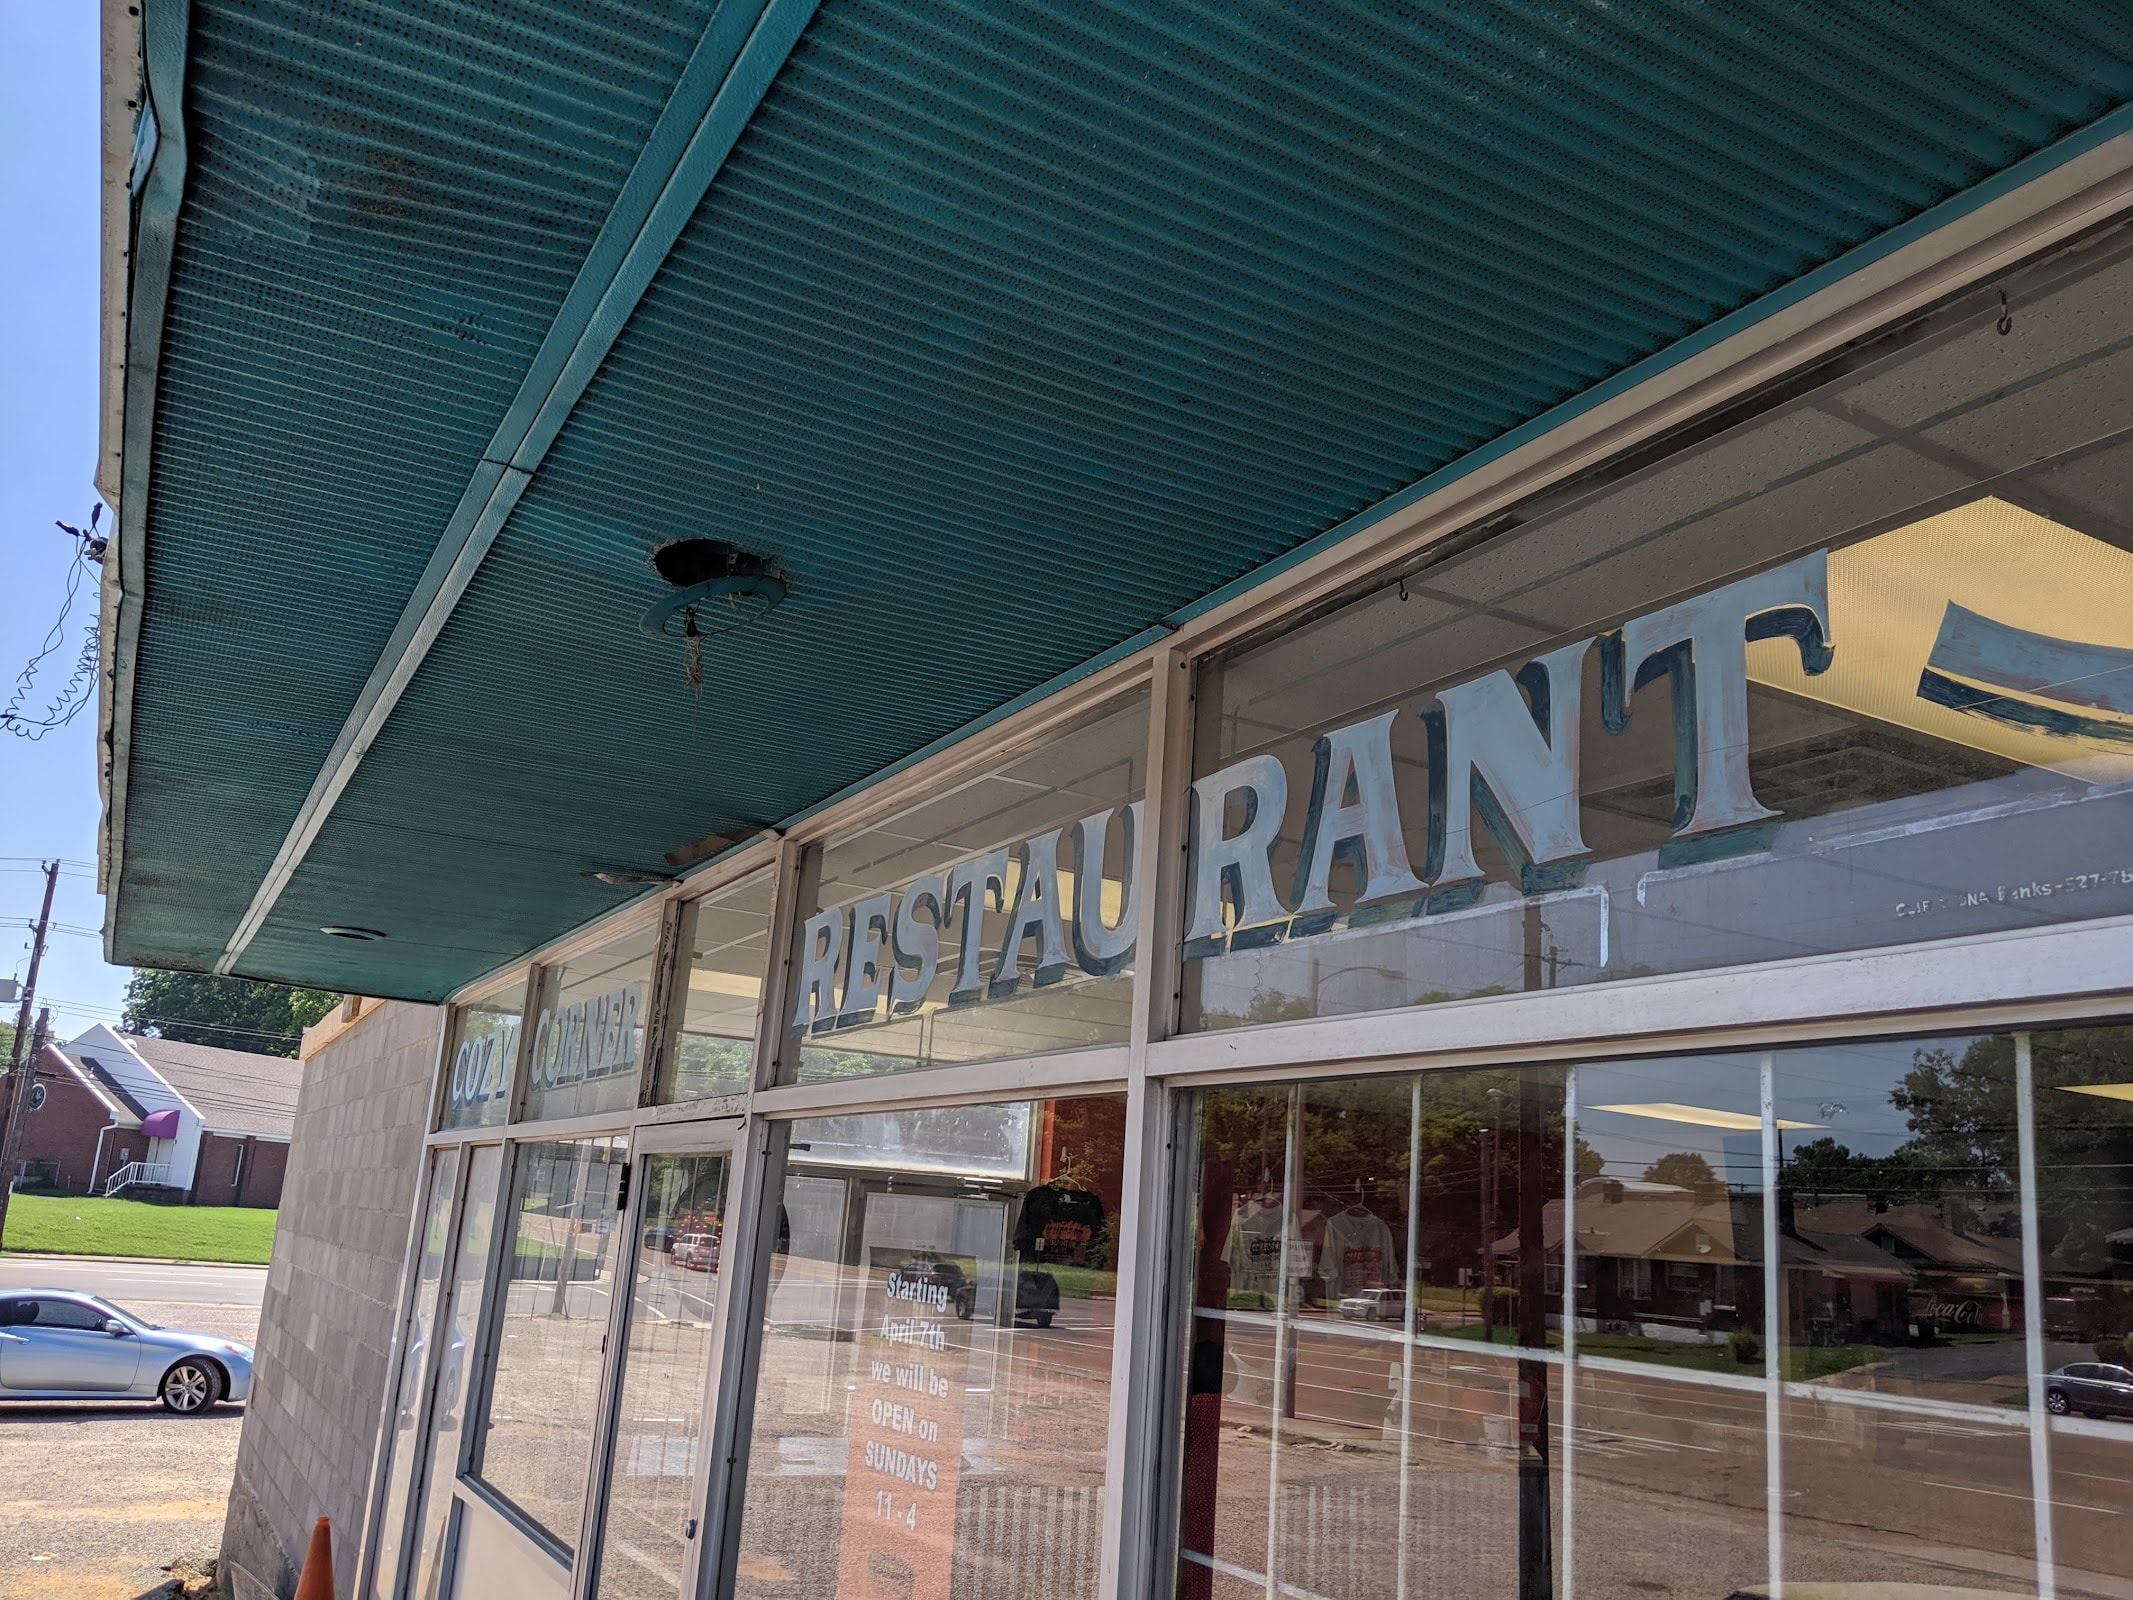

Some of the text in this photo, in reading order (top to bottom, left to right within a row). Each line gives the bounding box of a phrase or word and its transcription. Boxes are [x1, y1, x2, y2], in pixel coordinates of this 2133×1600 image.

[452, 547, 1835, 1109] COZY CORNER RESTAURANT
[887, 1272, 948, 1312] Starting
[880, 1314, 945, 1351] April 7th
[871, 1361, 948, 1398] we will be
[872, 1398, 938, 1443] OPEN on
[865, 1440, 937, 1490] SUNDAYS
[875, 1488, 892, 1520] 11
[906, 1503, 917, 1531] 4
